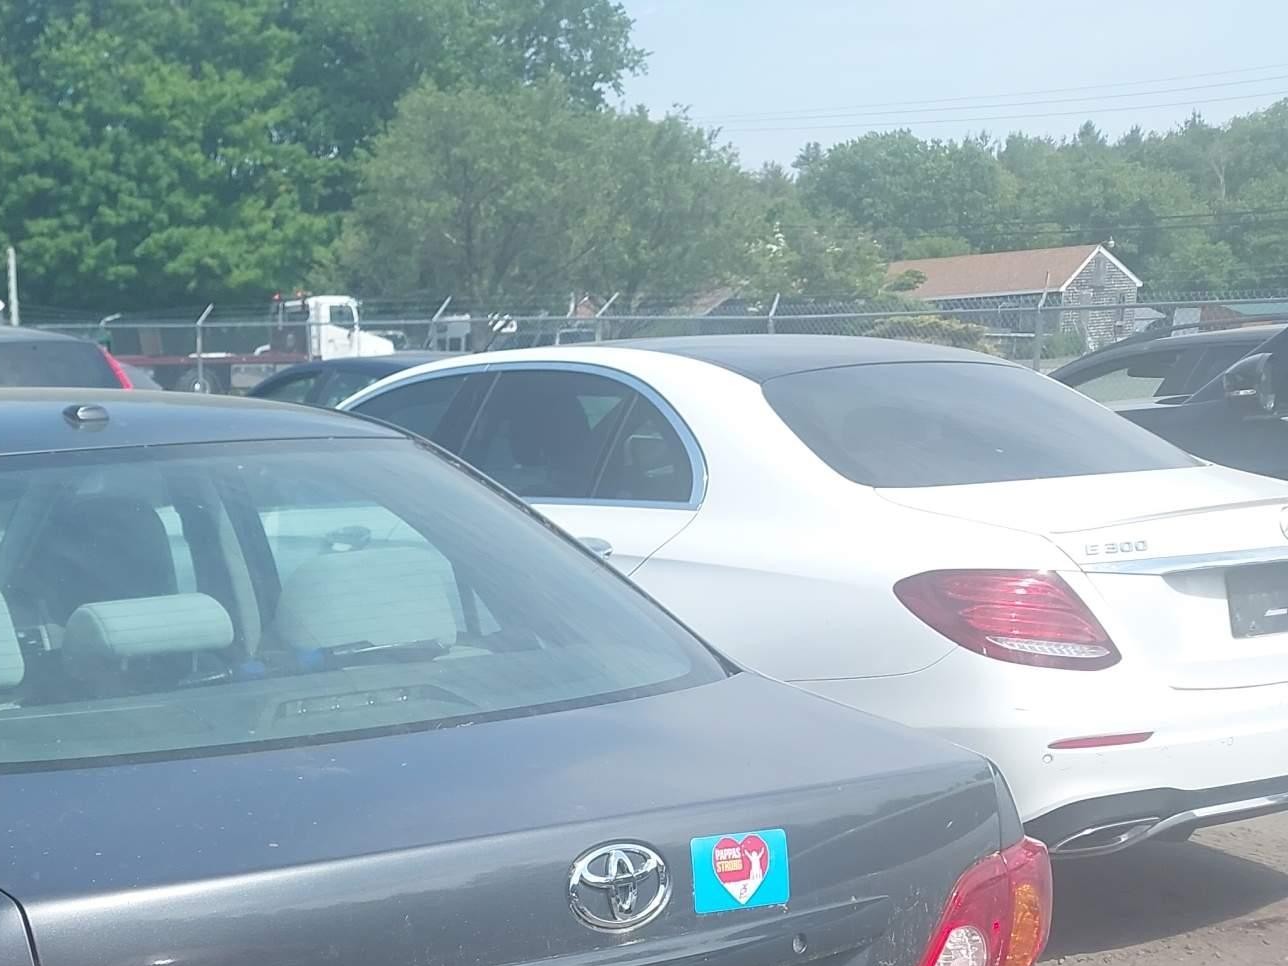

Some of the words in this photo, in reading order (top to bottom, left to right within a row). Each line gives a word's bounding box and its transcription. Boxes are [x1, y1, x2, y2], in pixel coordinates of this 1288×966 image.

[1085, 543, 1099, 556] E
[1104, 540, 1148, 555] 300
[715, 847, 741, 861] PAPPAS
[716, 860, 743, 873] STRONG
